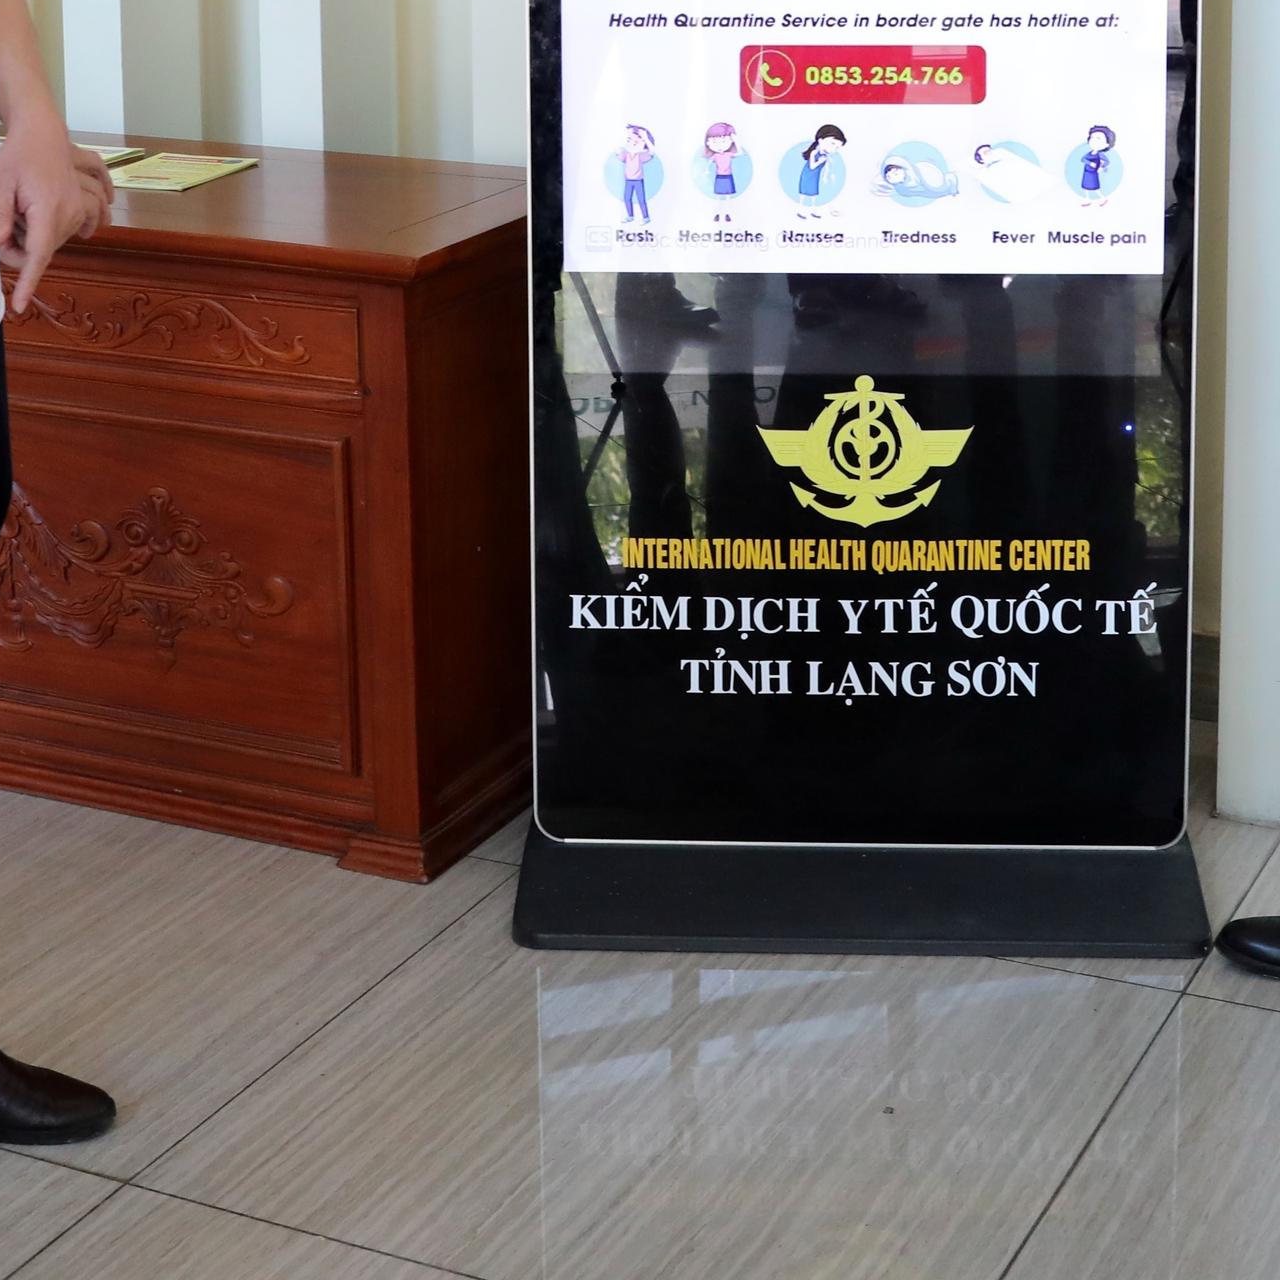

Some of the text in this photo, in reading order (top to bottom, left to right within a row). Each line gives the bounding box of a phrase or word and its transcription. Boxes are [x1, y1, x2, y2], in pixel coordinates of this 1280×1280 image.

[608, 12, 1120, 32] Health Quarantine Service in border gate has hotline at:
[805, 66, 964, 86] 0853.254.766
[616, 229, 654, 243] Rash
[679, 229, 764, 243] Headache
[782, 230, 844, 243] Nausea
[881, 230, 957, 244] Tiredness
[992, 230, 1035, 244] Fever
[1048, 231, 1146, 246] Muscle pain
[622, 537, 1090, 575] INTERNATIONAL HEALTH QUARANTINE CENTER
[568, 573, 692, 631] KIỂM
[703, 596, 821, 640] DỊCH
[950, 583, 1082, 639] QUỐC
[1095, 582, 1157, 635] TẾ
[680, 647, 1040, 706] TỈNH LẠNG SƠN
